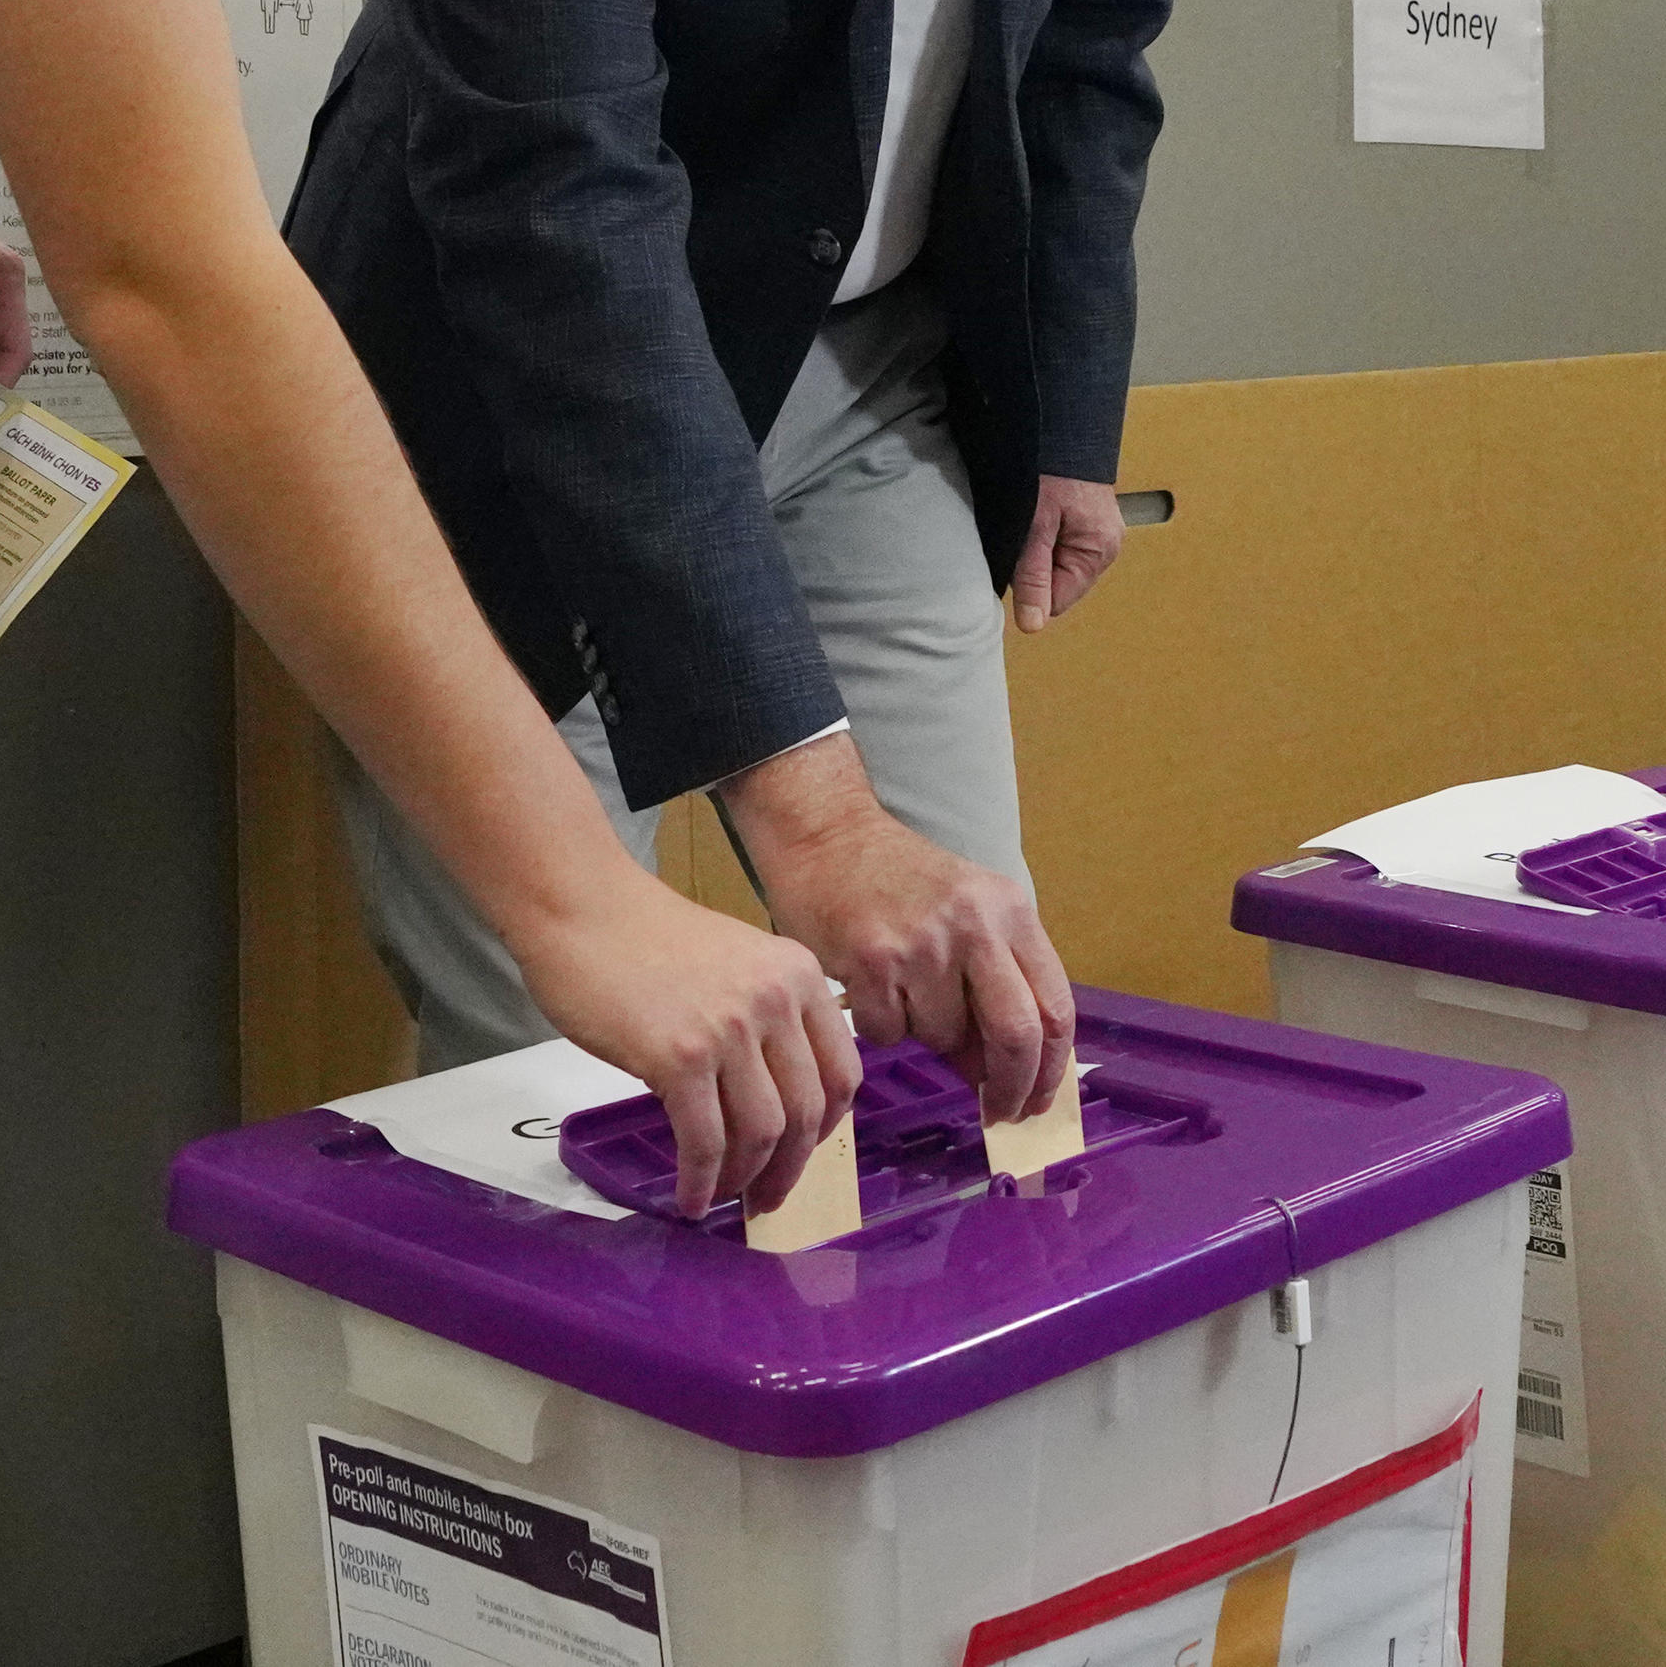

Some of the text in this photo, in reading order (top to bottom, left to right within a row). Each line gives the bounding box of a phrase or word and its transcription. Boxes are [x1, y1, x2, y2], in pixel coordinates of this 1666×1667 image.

[1407, 0, 1497, 49] Sydney
[43, 362, 64, 375] you
[66, 362, 84, 374] for
[1, 465, 57, 507] BALLOT PAPER
[81, 474, 102, 492] YES
[1533, 1239, 1558, 1254] PQQ
[328, 1453, 533, 1540] Pre-poll and mobile ballot box
[332, 1485, 503, 1559] OPENING INSTRUCTIONS
[338, 1541, 402, 1576] ORDINARY
[592, 1557, 611, 1576] AEC
[341, 1561, 430, 1606] MOBILE VOTES
